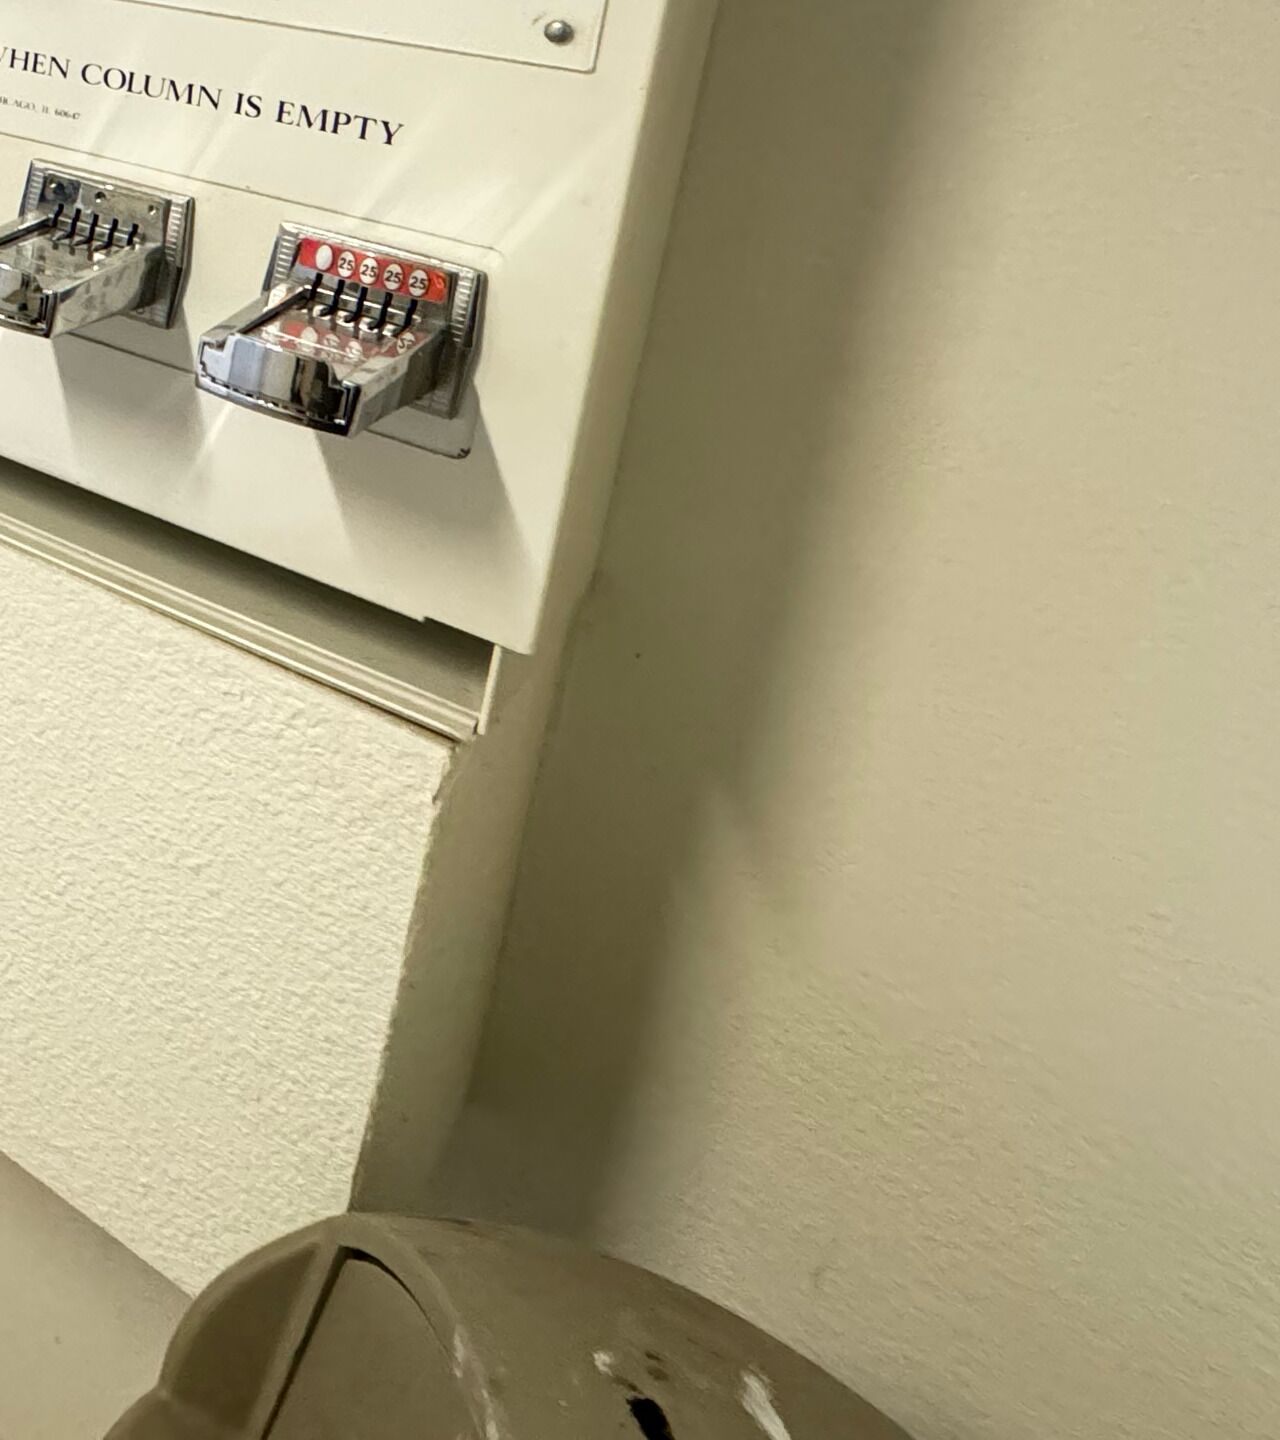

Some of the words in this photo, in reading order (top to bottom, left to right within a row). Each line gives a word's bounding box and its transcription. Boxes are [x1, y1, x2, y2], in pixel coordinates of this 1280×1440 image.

[80, 62, 223, 111] COLUMN
[233, 89, 263, 119] IS
[274, 100, 406, 148] EMPTY
[339, 258, 354, 271] 25
[361, 264, 376, 278] 25
[384, 270, 402, 283] 25
[409, 276, 426, 290] 25
